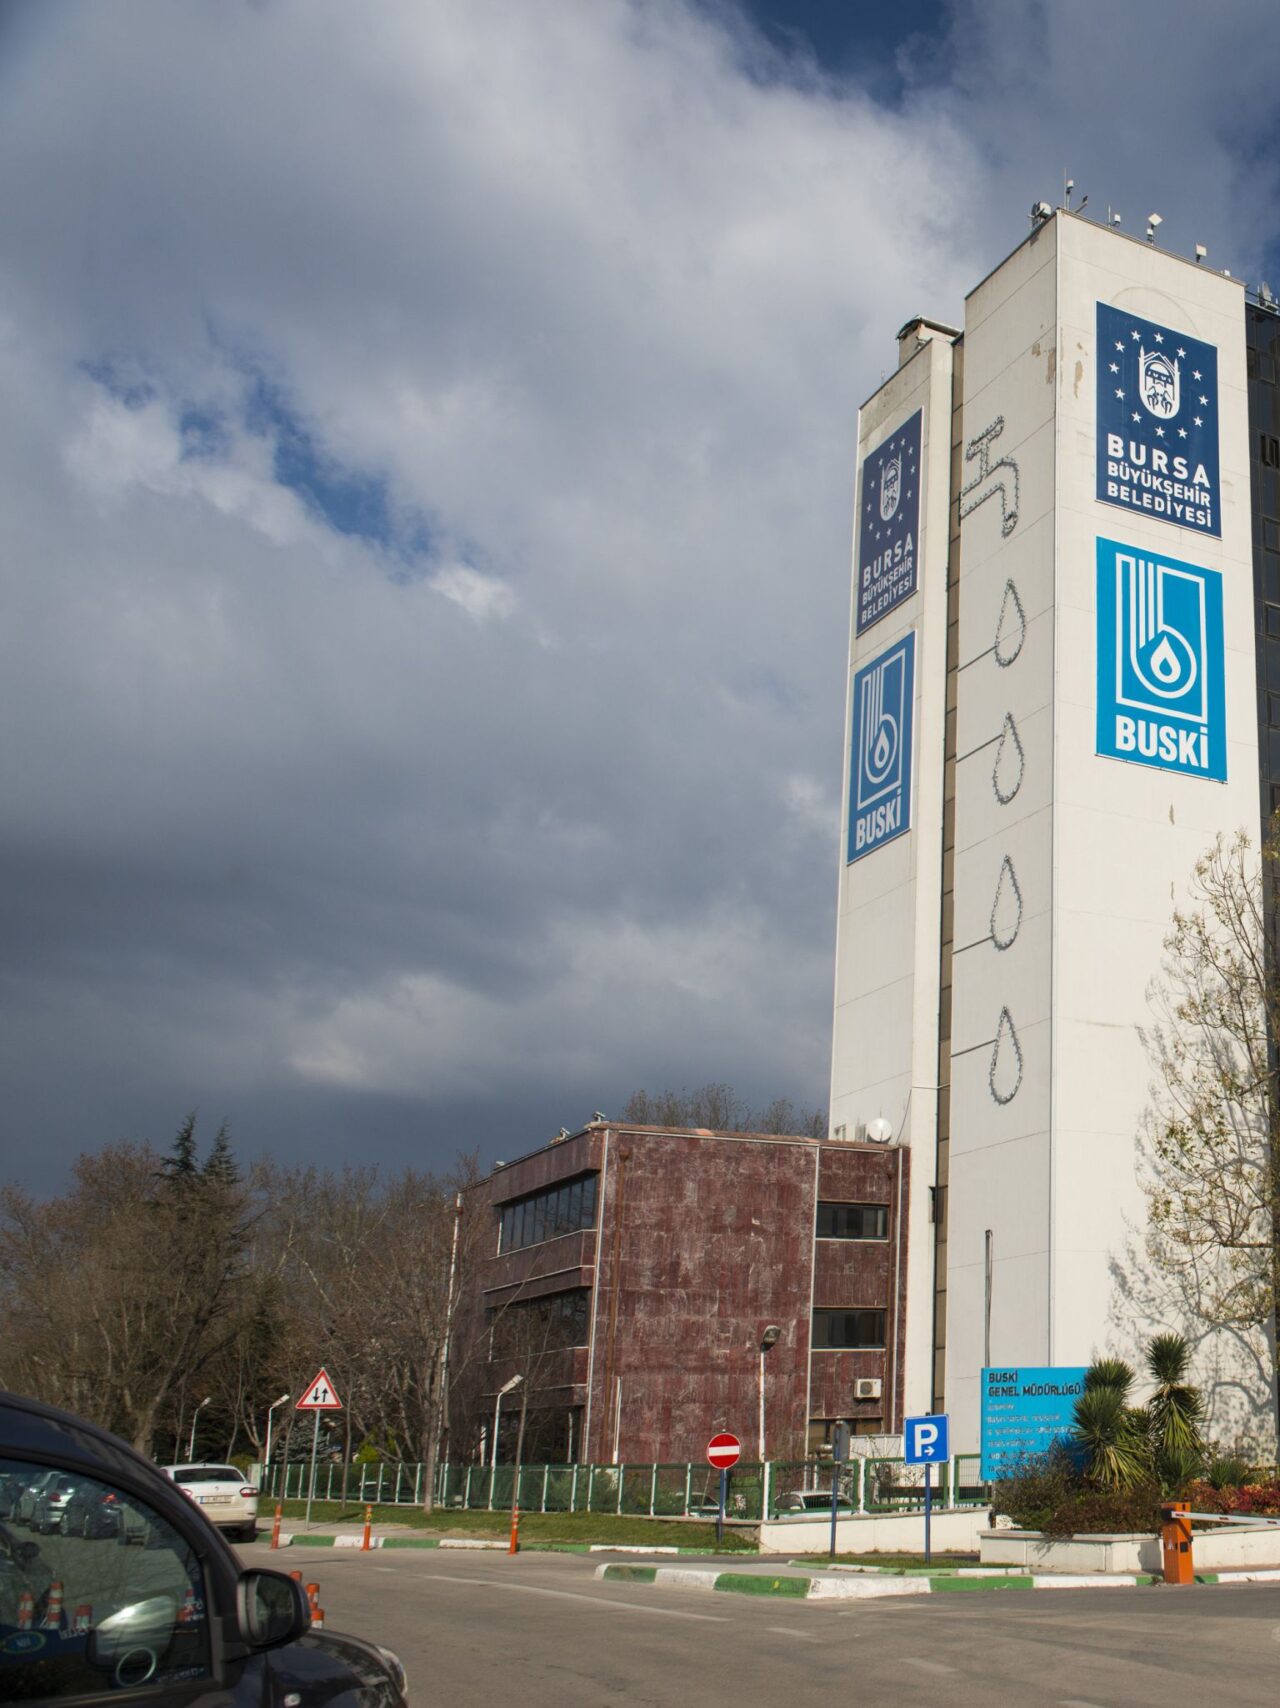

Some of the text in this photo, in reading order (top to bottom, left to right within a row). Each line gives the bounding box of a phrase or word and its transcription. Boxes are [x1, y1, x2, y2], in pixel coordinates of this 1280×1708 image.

[1107, 433, 1211, 488] BURSA
[1107, 460, 1211, 508] BÜYÜKŞEHİR
[1107, 481, 1212, 528] BELEDİYESİ
[862, 556, 913, 606] BÜYÜKŞEHİR
[863, 532, 913, 588] BURSA
[861, 570, 913, 624] BELEDİYESİ
[1115, 714, 1209, 769] BUSKİ
[855, 787, 902, 851] BUSKİ
[988, 1370, 1018, 1383] BUSKİ
[988, 1383, 1081, 1397] GENEL MÜDÜRLÜĞÜ
[914, 1423, 938, 1458] P
